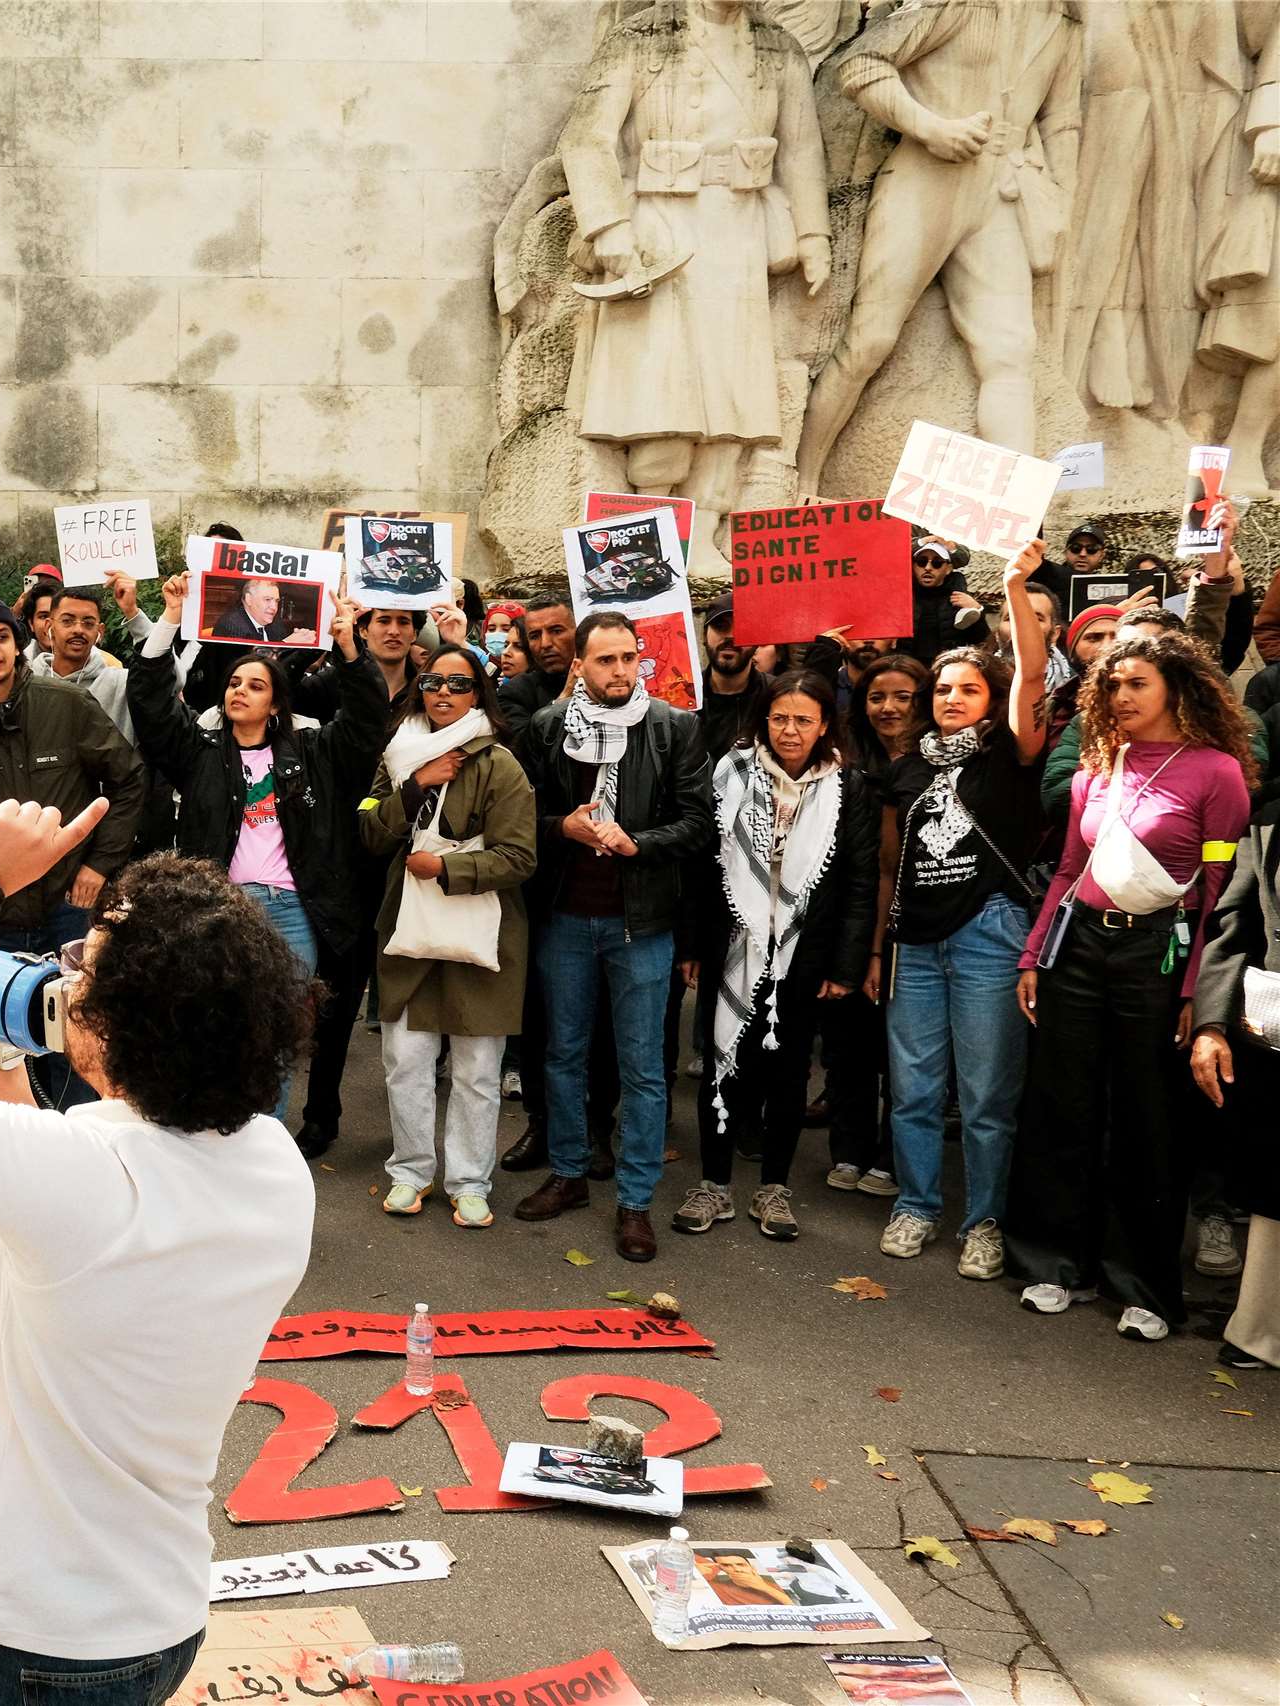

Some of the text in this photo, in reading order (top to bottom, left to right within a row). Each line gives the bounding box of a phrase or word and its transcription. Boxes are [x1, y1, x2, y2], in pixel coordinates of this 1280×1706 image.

[923, 436, 1019, 496] FREE
[391, 525, 428, 534] ROCKET
[391, 532, 408, 541] PIG
[610, 524, 650, 538] ROCKET
[612, 536, 630, 547] PIG
[734, 535, 820, 560] SANTE
[219, 542, 308, 578] basta!
[228, 1373, 771, 1525] 212
